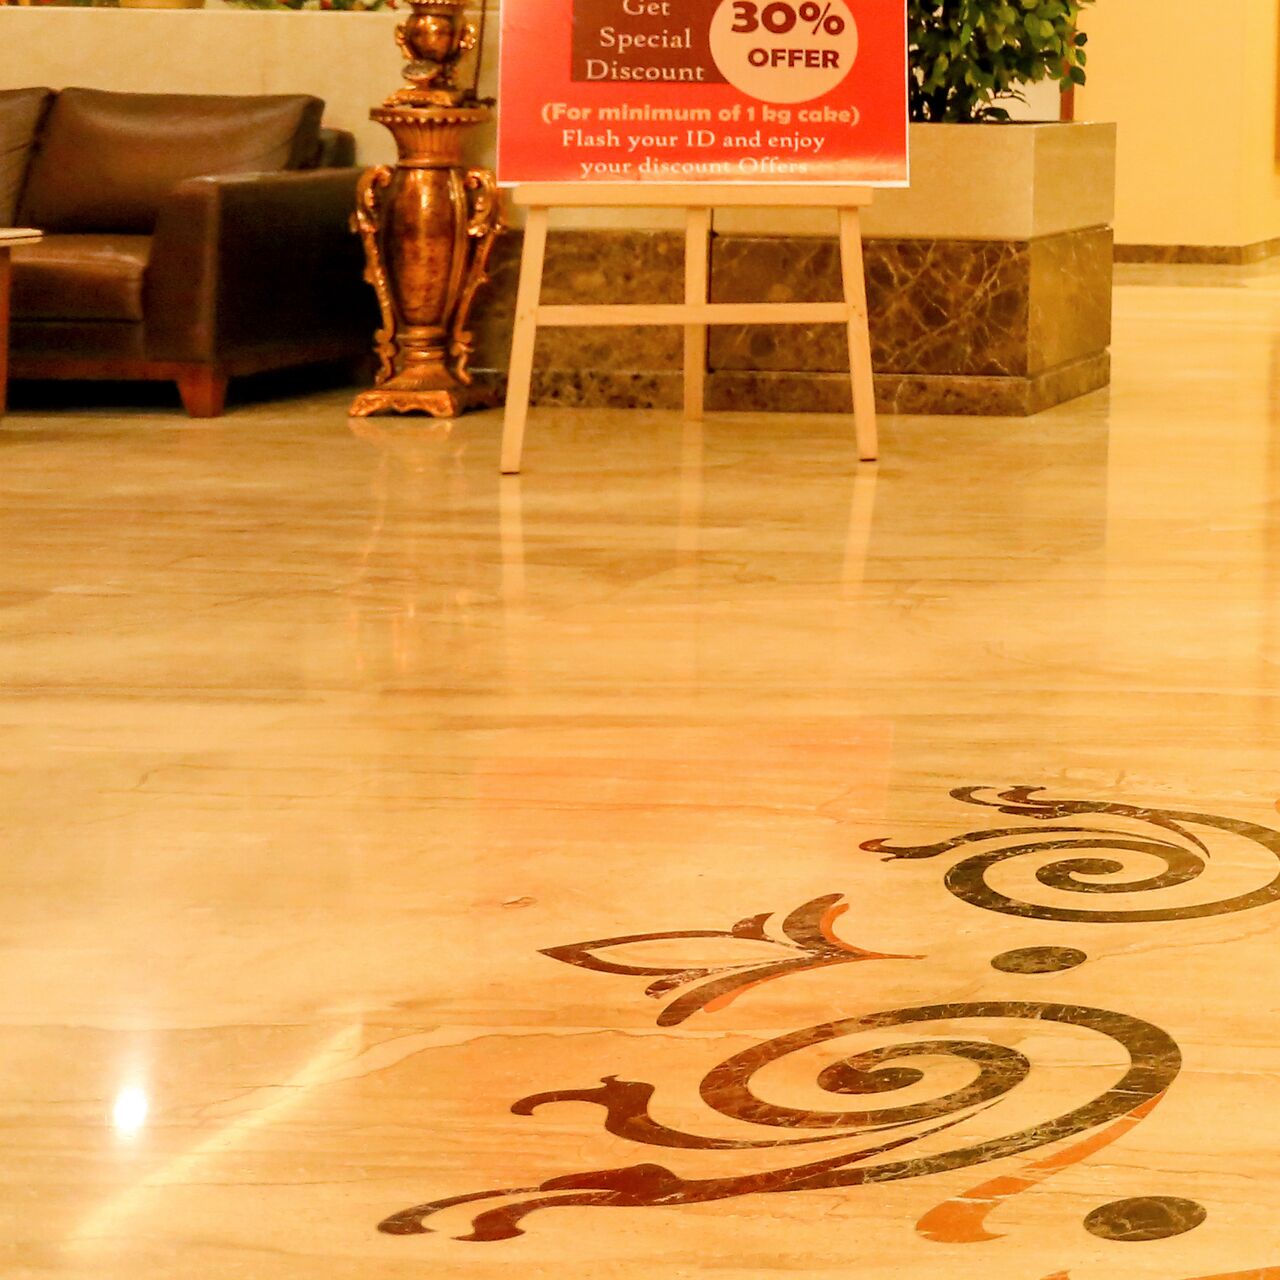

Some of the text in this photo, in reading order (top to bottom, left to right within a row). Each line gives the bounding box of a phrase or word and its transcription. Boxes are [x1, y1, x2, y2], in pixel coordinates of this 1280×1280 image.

[731, 0, 845, 36] 30%
[600, 26, 692, 55] Special
[586, 58, 704, 82] Discount
[747, 48, 839, 69] OFFER
[541, 102, 860, 127] (For minimum of 1 kg cake)
[562, 129, 825, 154] Flash your ID and enjoy
[580, 156, 809, 178] your discount Offers
